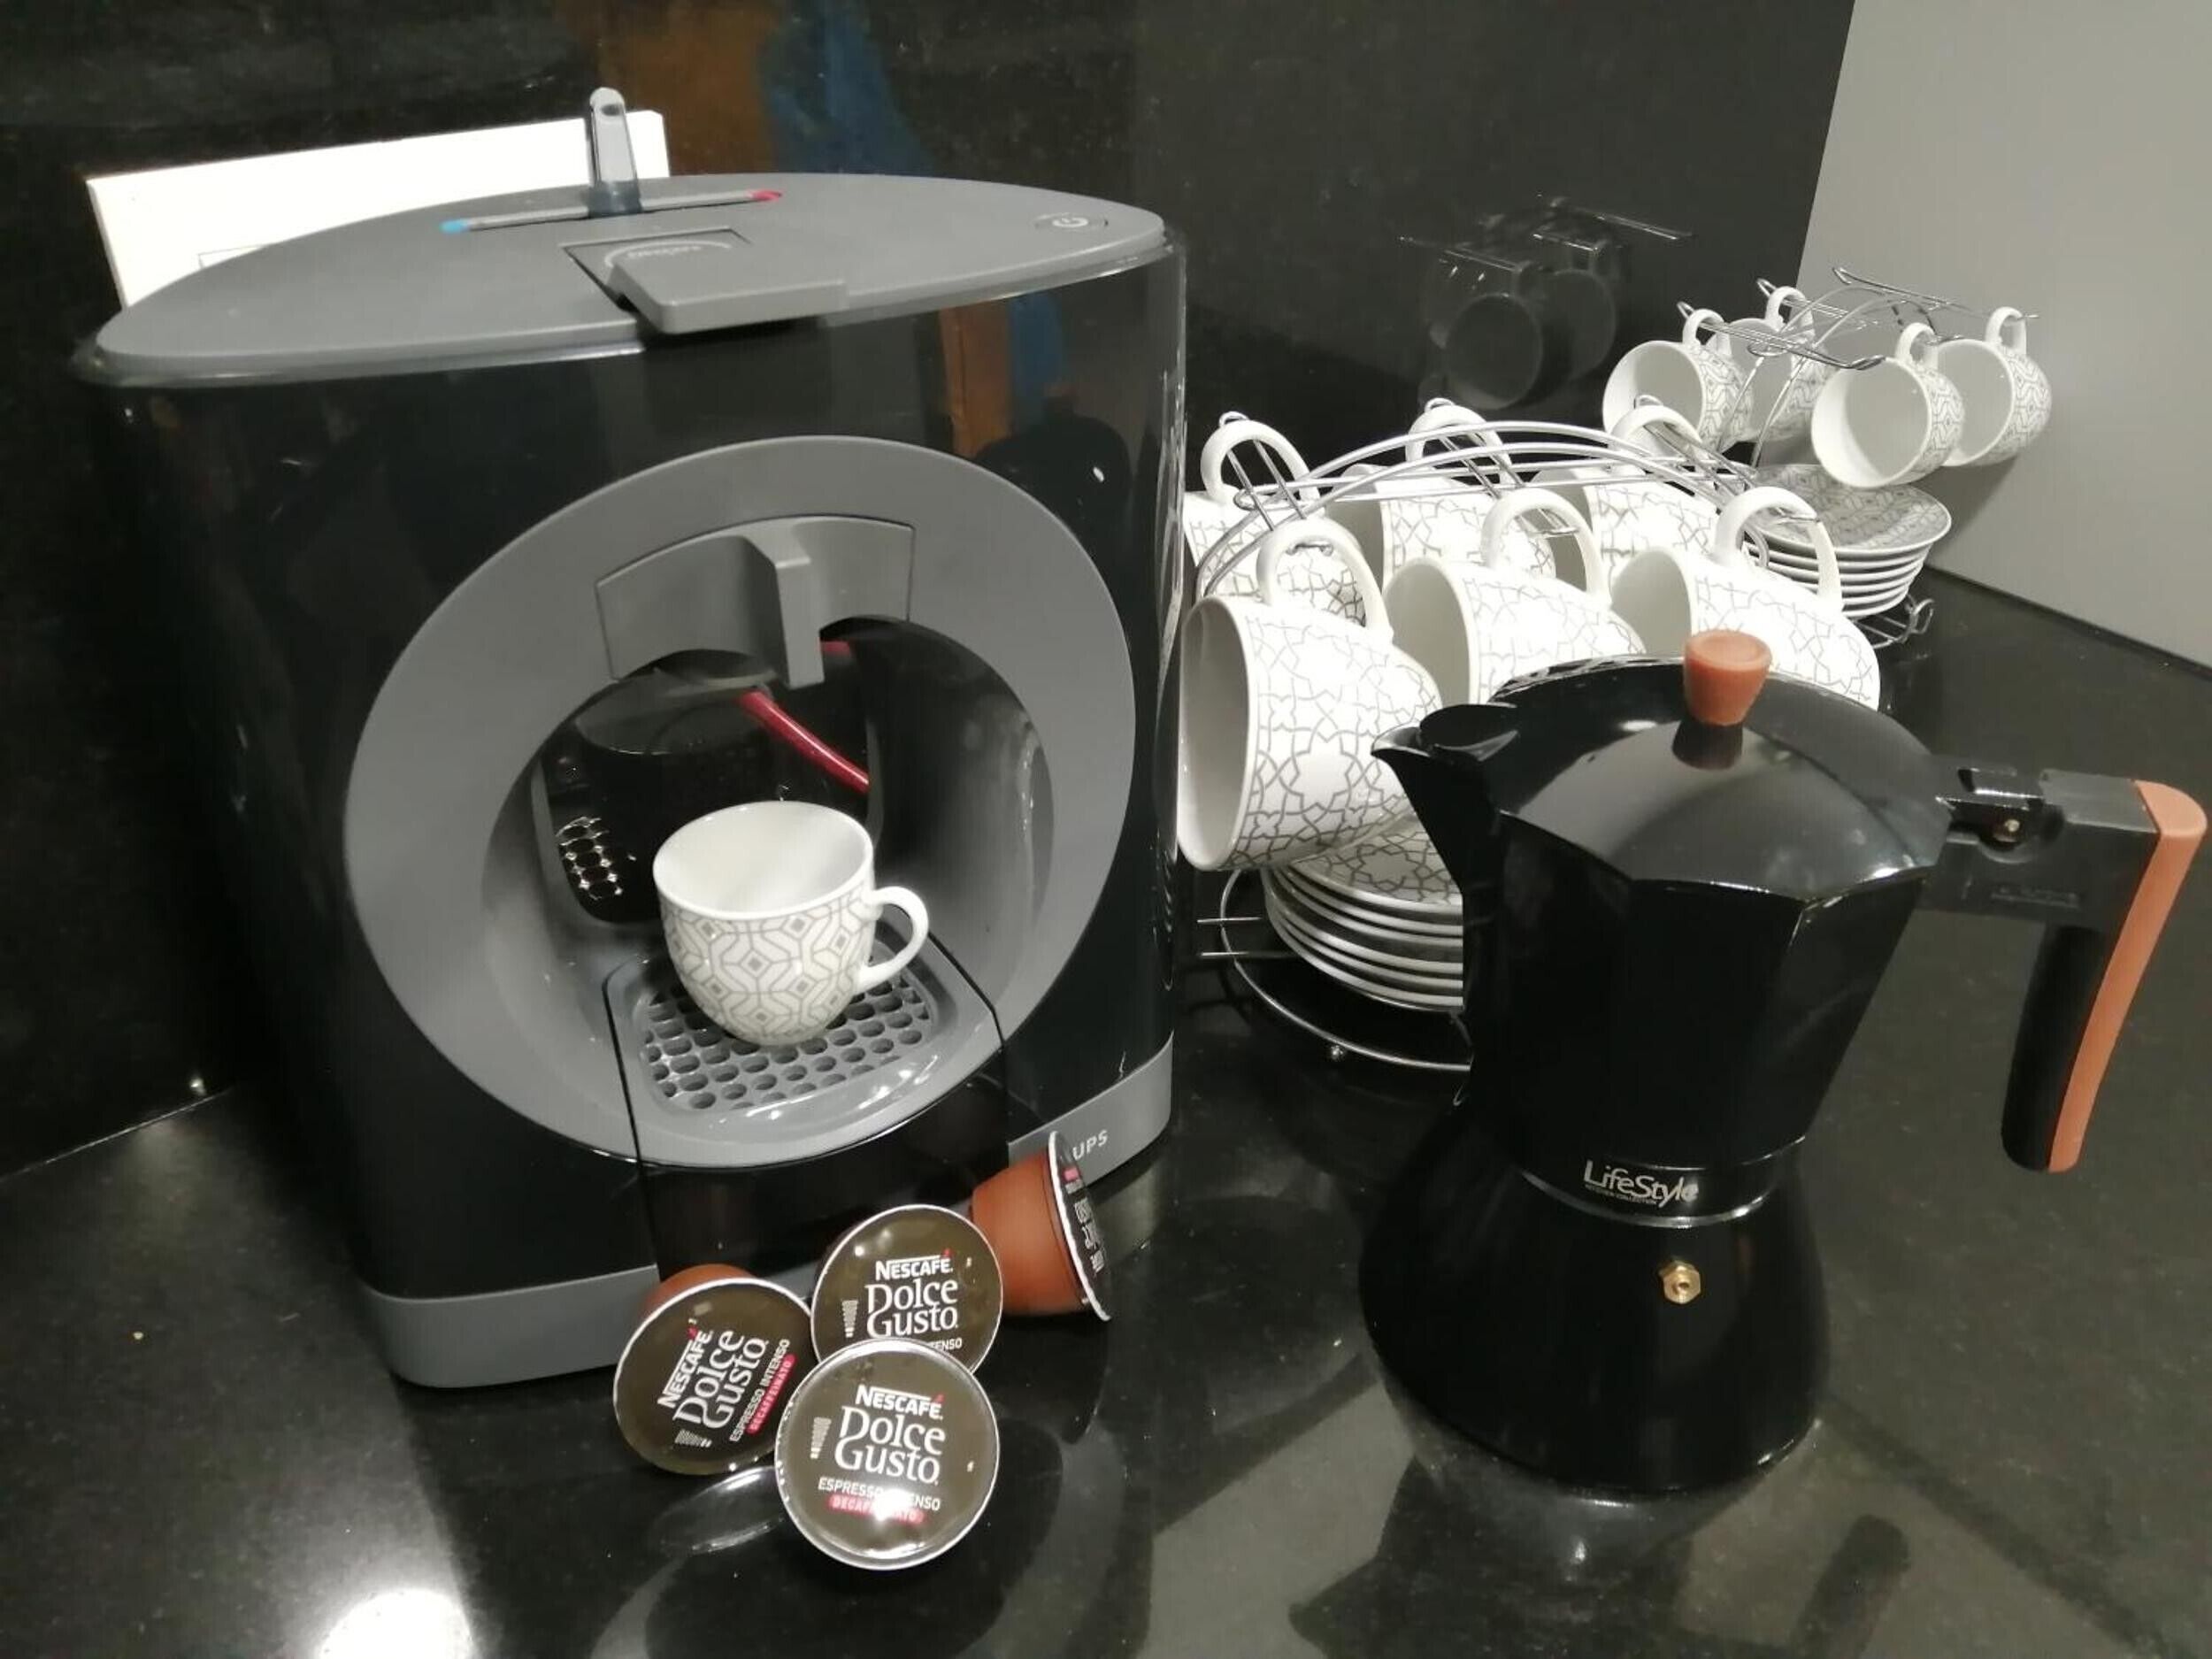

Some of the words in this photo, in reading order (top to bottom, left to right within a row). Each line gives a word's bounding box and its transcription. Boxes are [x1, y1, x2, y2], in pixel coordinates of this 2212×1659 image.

[1583, 1159, 1700, 1209] LifeStyle
[864, 1278, 958, 1314] Dolce
[866, 1303, 958, 1339] Gusto
[672, 1330, 745, 1425] Dolce
[701, 1337, 768, 1429] Gusto
[840, 1405, 946, 1455] Dolce
[834, 1435, 941, 1486] Gusto
